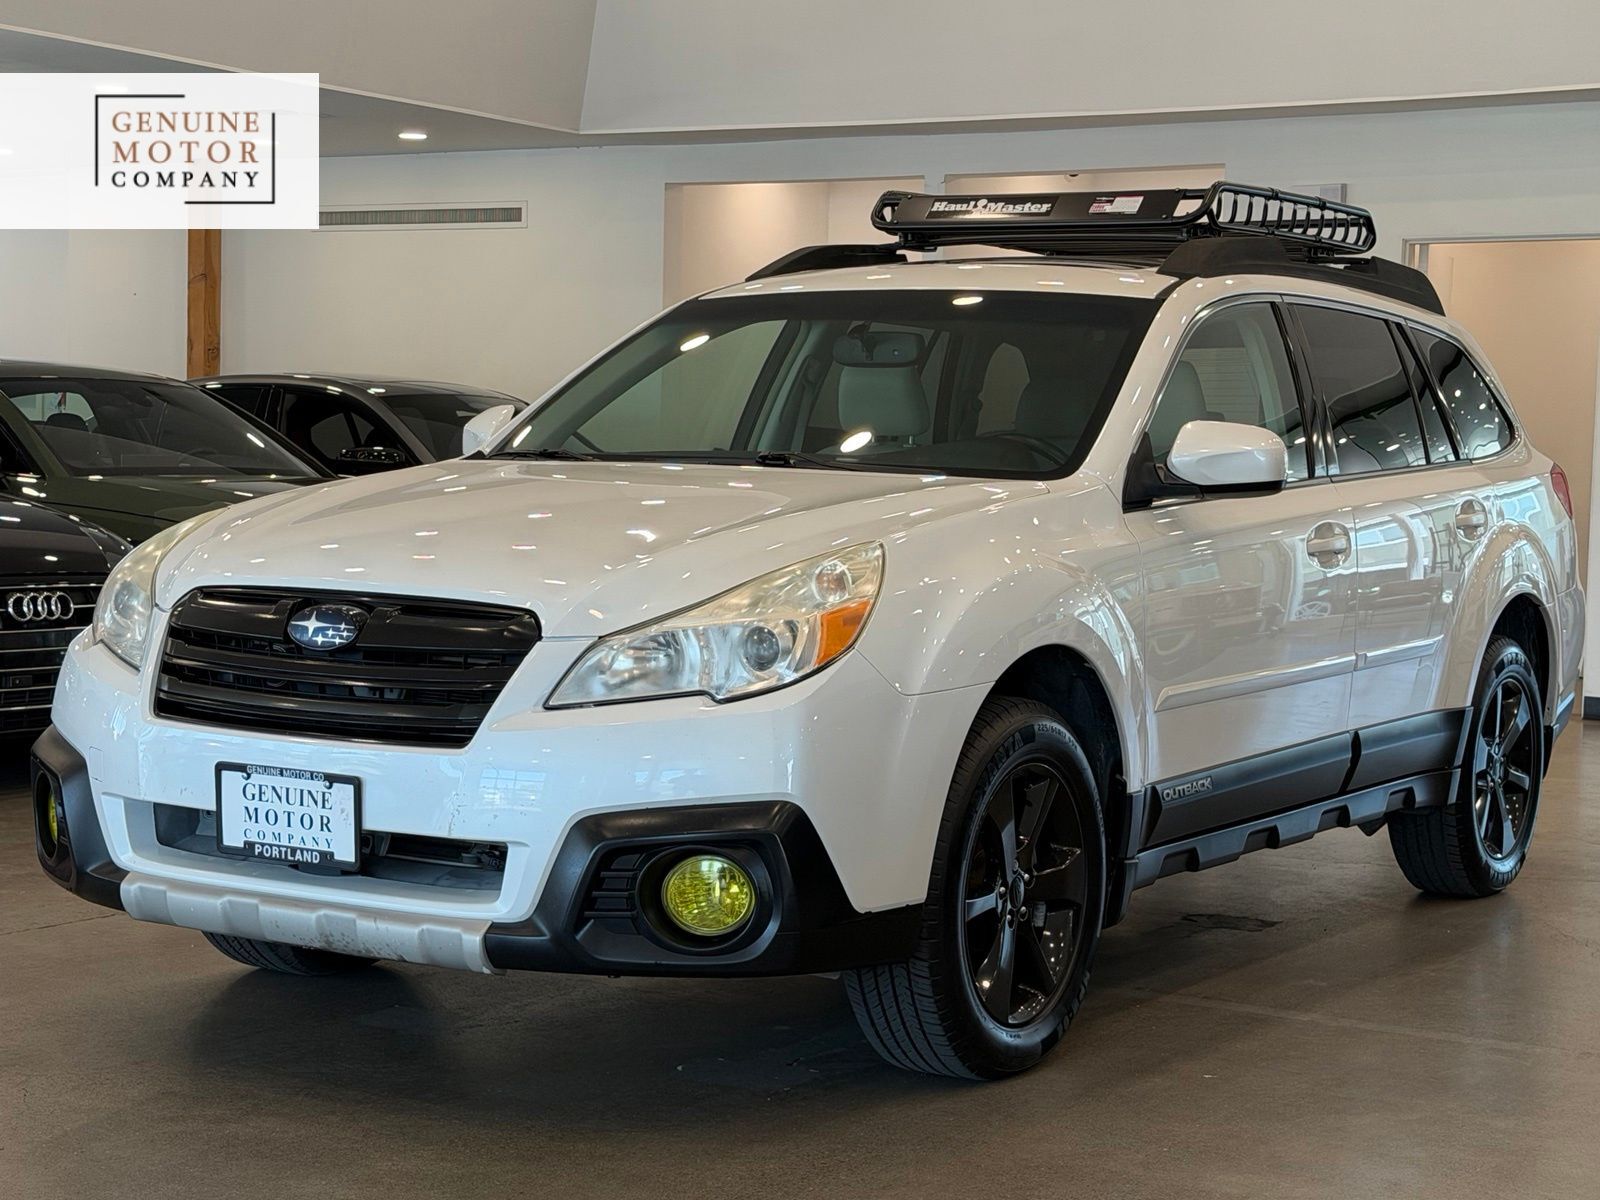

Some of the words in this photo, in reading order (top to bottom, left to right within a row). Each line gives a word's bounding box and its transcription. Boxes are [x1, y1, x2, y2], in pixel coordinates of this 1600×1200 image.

[931, 201, 975, 212] Haul
[985, 201, 1052, 213] Master
[246, 765, 281, 776] GENUINE
[282, 769, 312, 780] MOTOR
[242, 782, 333, 810] GENUINE
[1163, 776, 1213, 801] OUTBACK
[243, 805, 333, 833] MOTOR
[243, 828, 334, 849] COMPANY
[254, 843, 321, 864] PORTLAND
